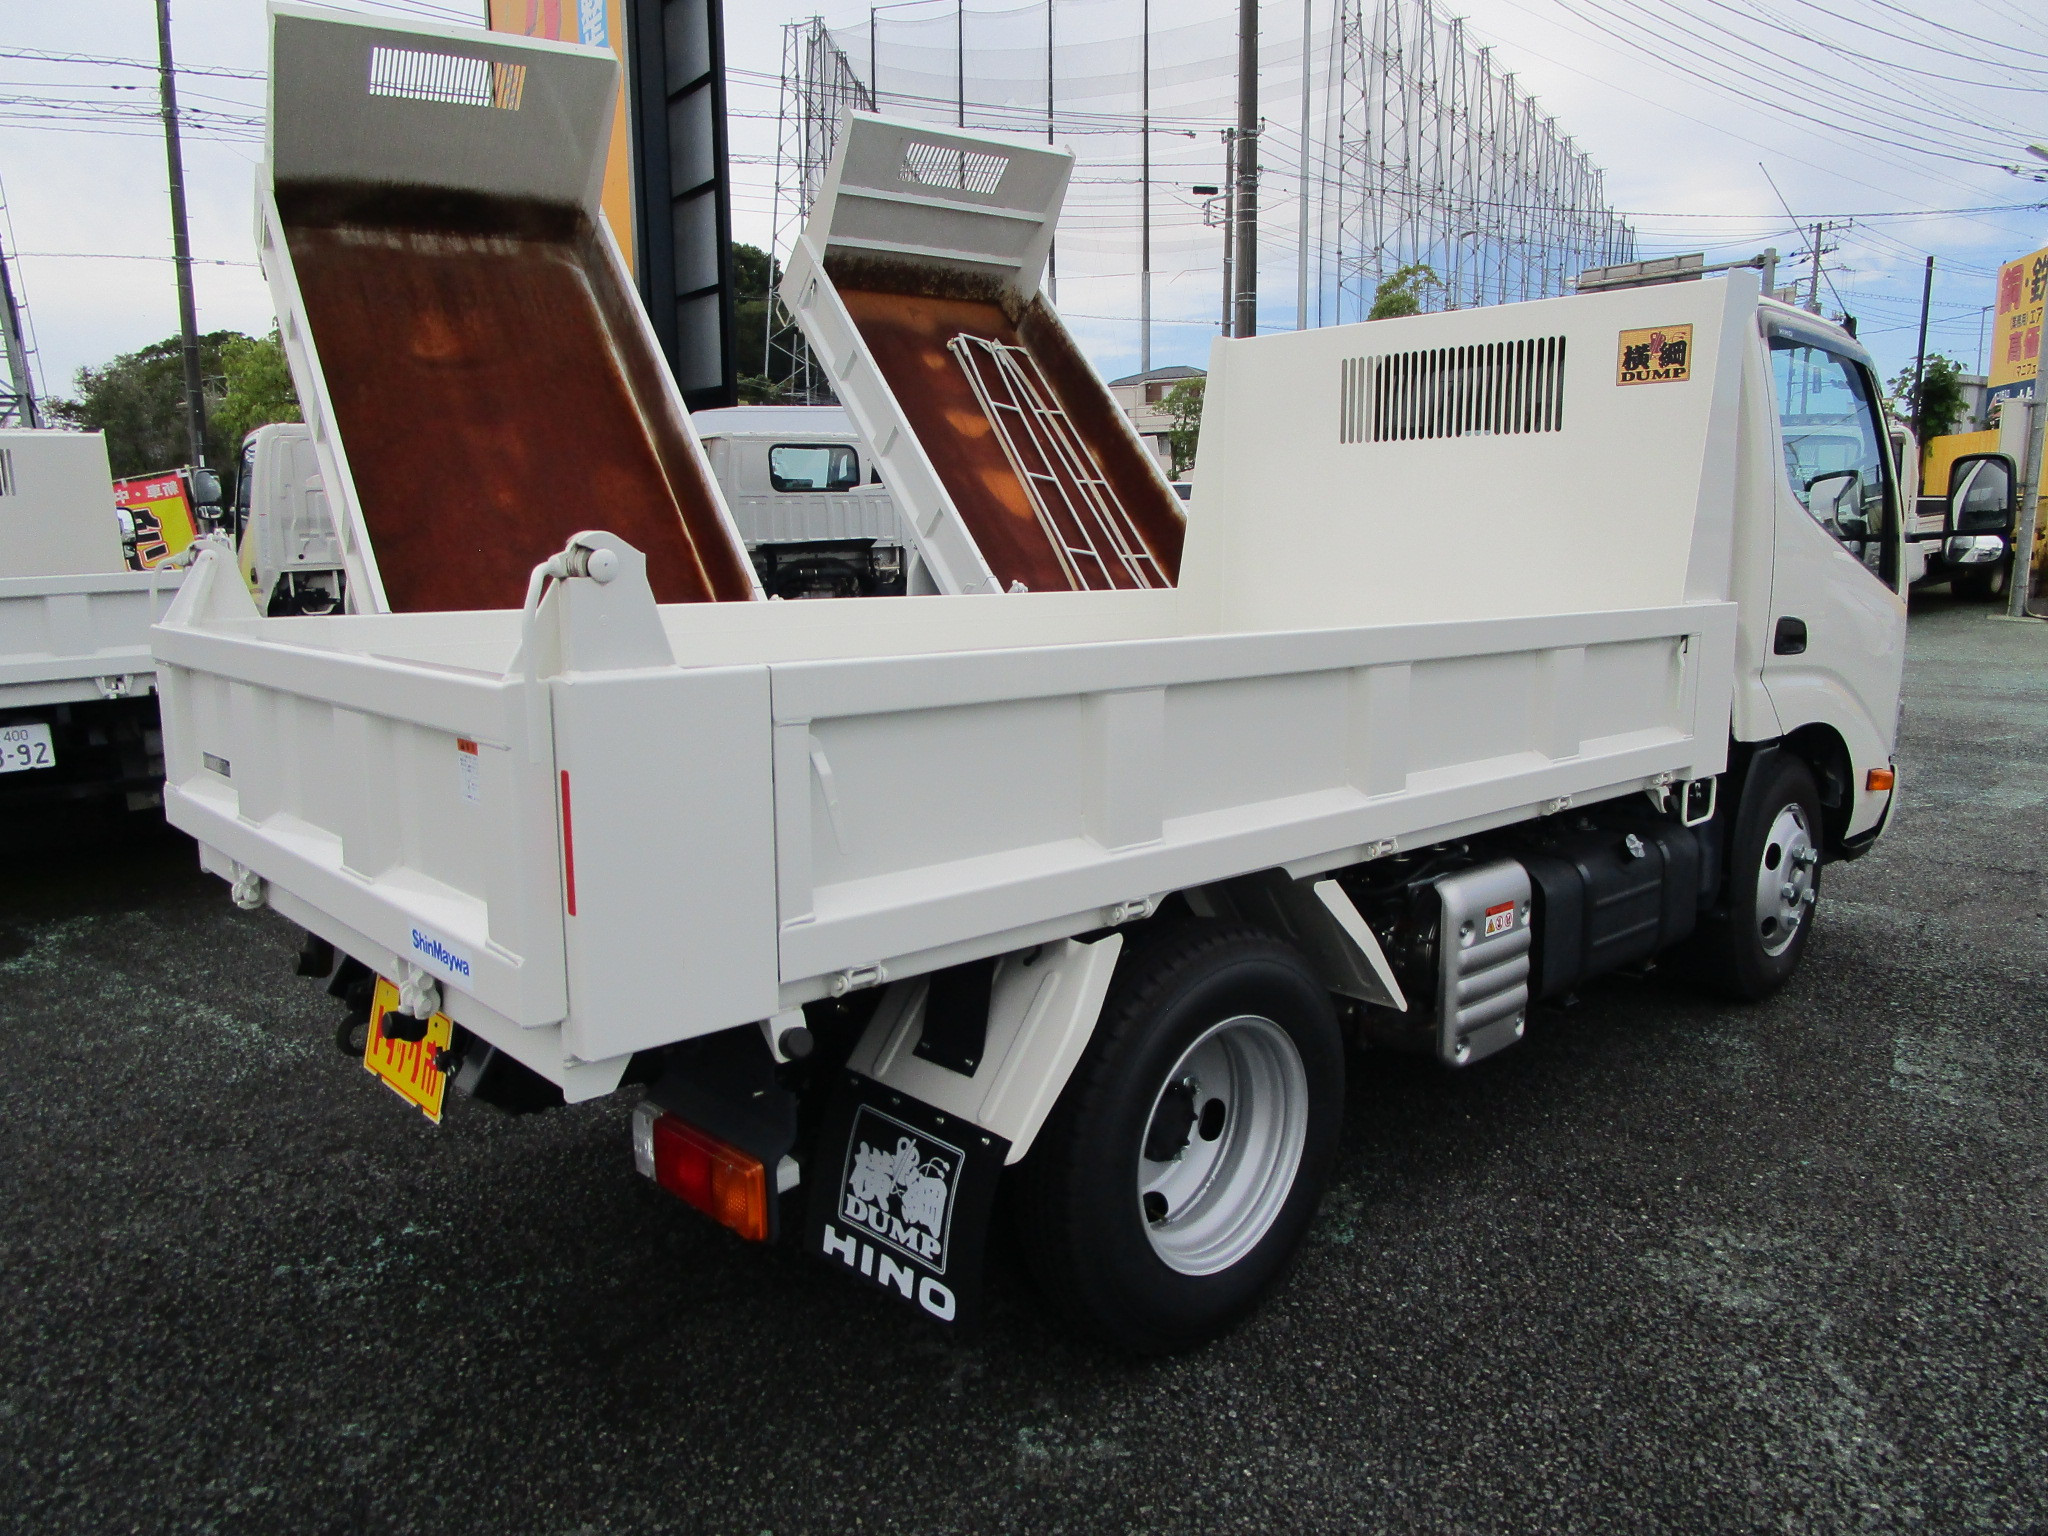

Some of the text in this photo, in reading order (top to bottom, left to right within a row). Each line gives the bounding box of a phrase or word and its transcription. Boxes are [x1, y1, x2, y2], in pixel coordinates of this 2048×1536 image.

[1621, 367, 1687, 382] DUMP
[4, 729, 28, 742] 400
[412, 928, 470, 977] ShinMaywa
[844, 1193, 942, 1260] DUMP
[822, 1223, 957, 1323] HINO
